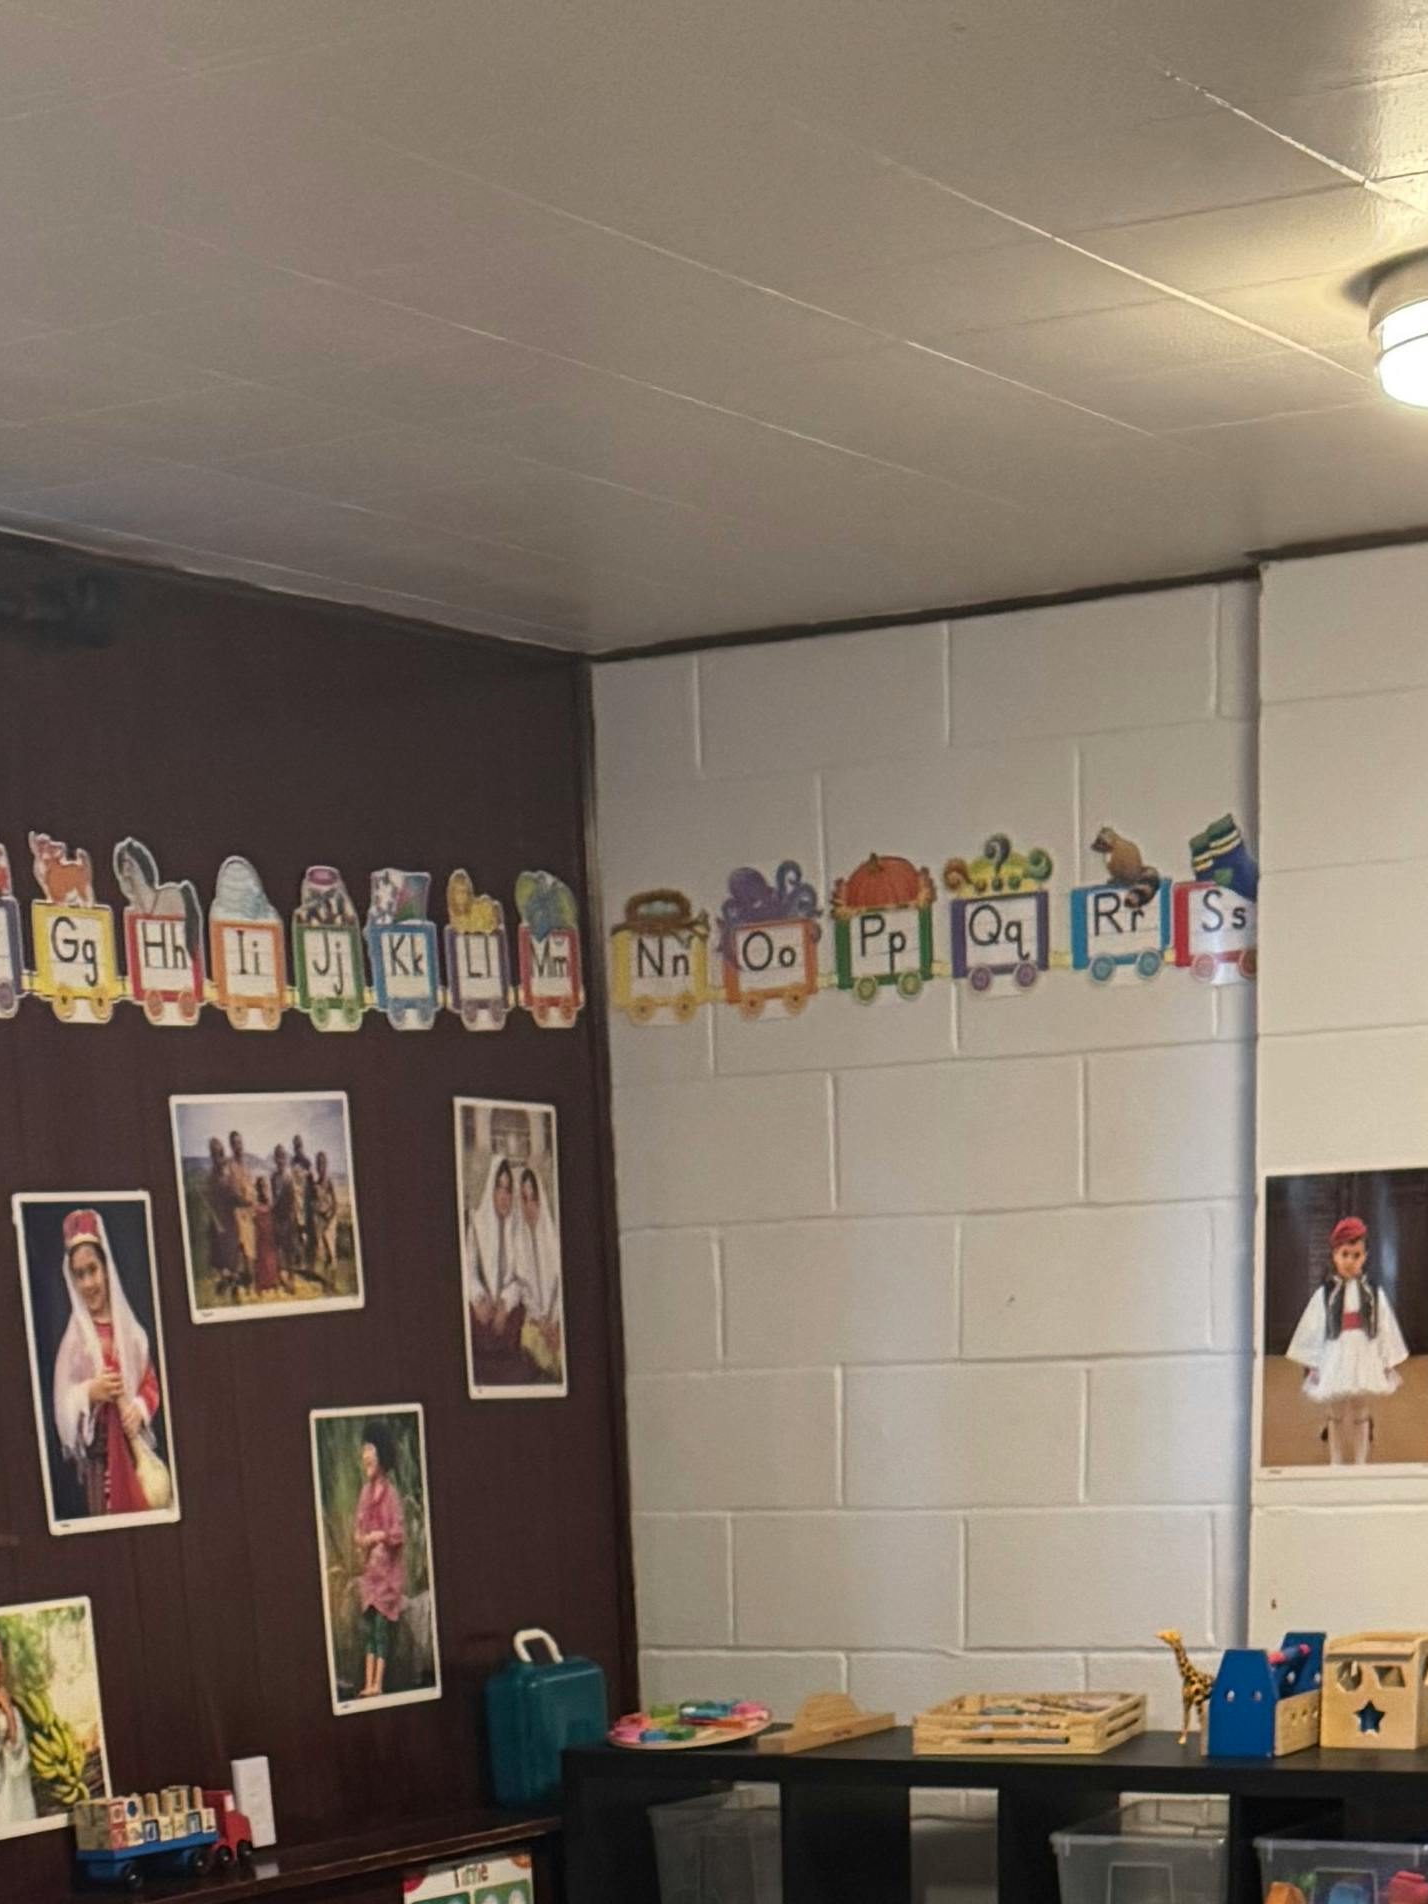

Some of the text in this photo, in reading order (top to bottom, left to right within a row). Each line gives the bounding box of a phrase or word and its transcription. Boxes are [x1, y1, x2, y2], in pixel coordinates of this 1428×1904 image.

[50, 916, 97, 987] Gg
[236, 929, 260, 971] Ii
[742, 931, 796, 970] Oo
[859, 916, 907, 971] Pp
[968, 904, 1027, 960] Qq
[313, 932, 345, 995] Jj
[390, 933, 423, 976] Kk
[466, 934, 491, 976] Ll
[637, 936, 690, 977] Nn
